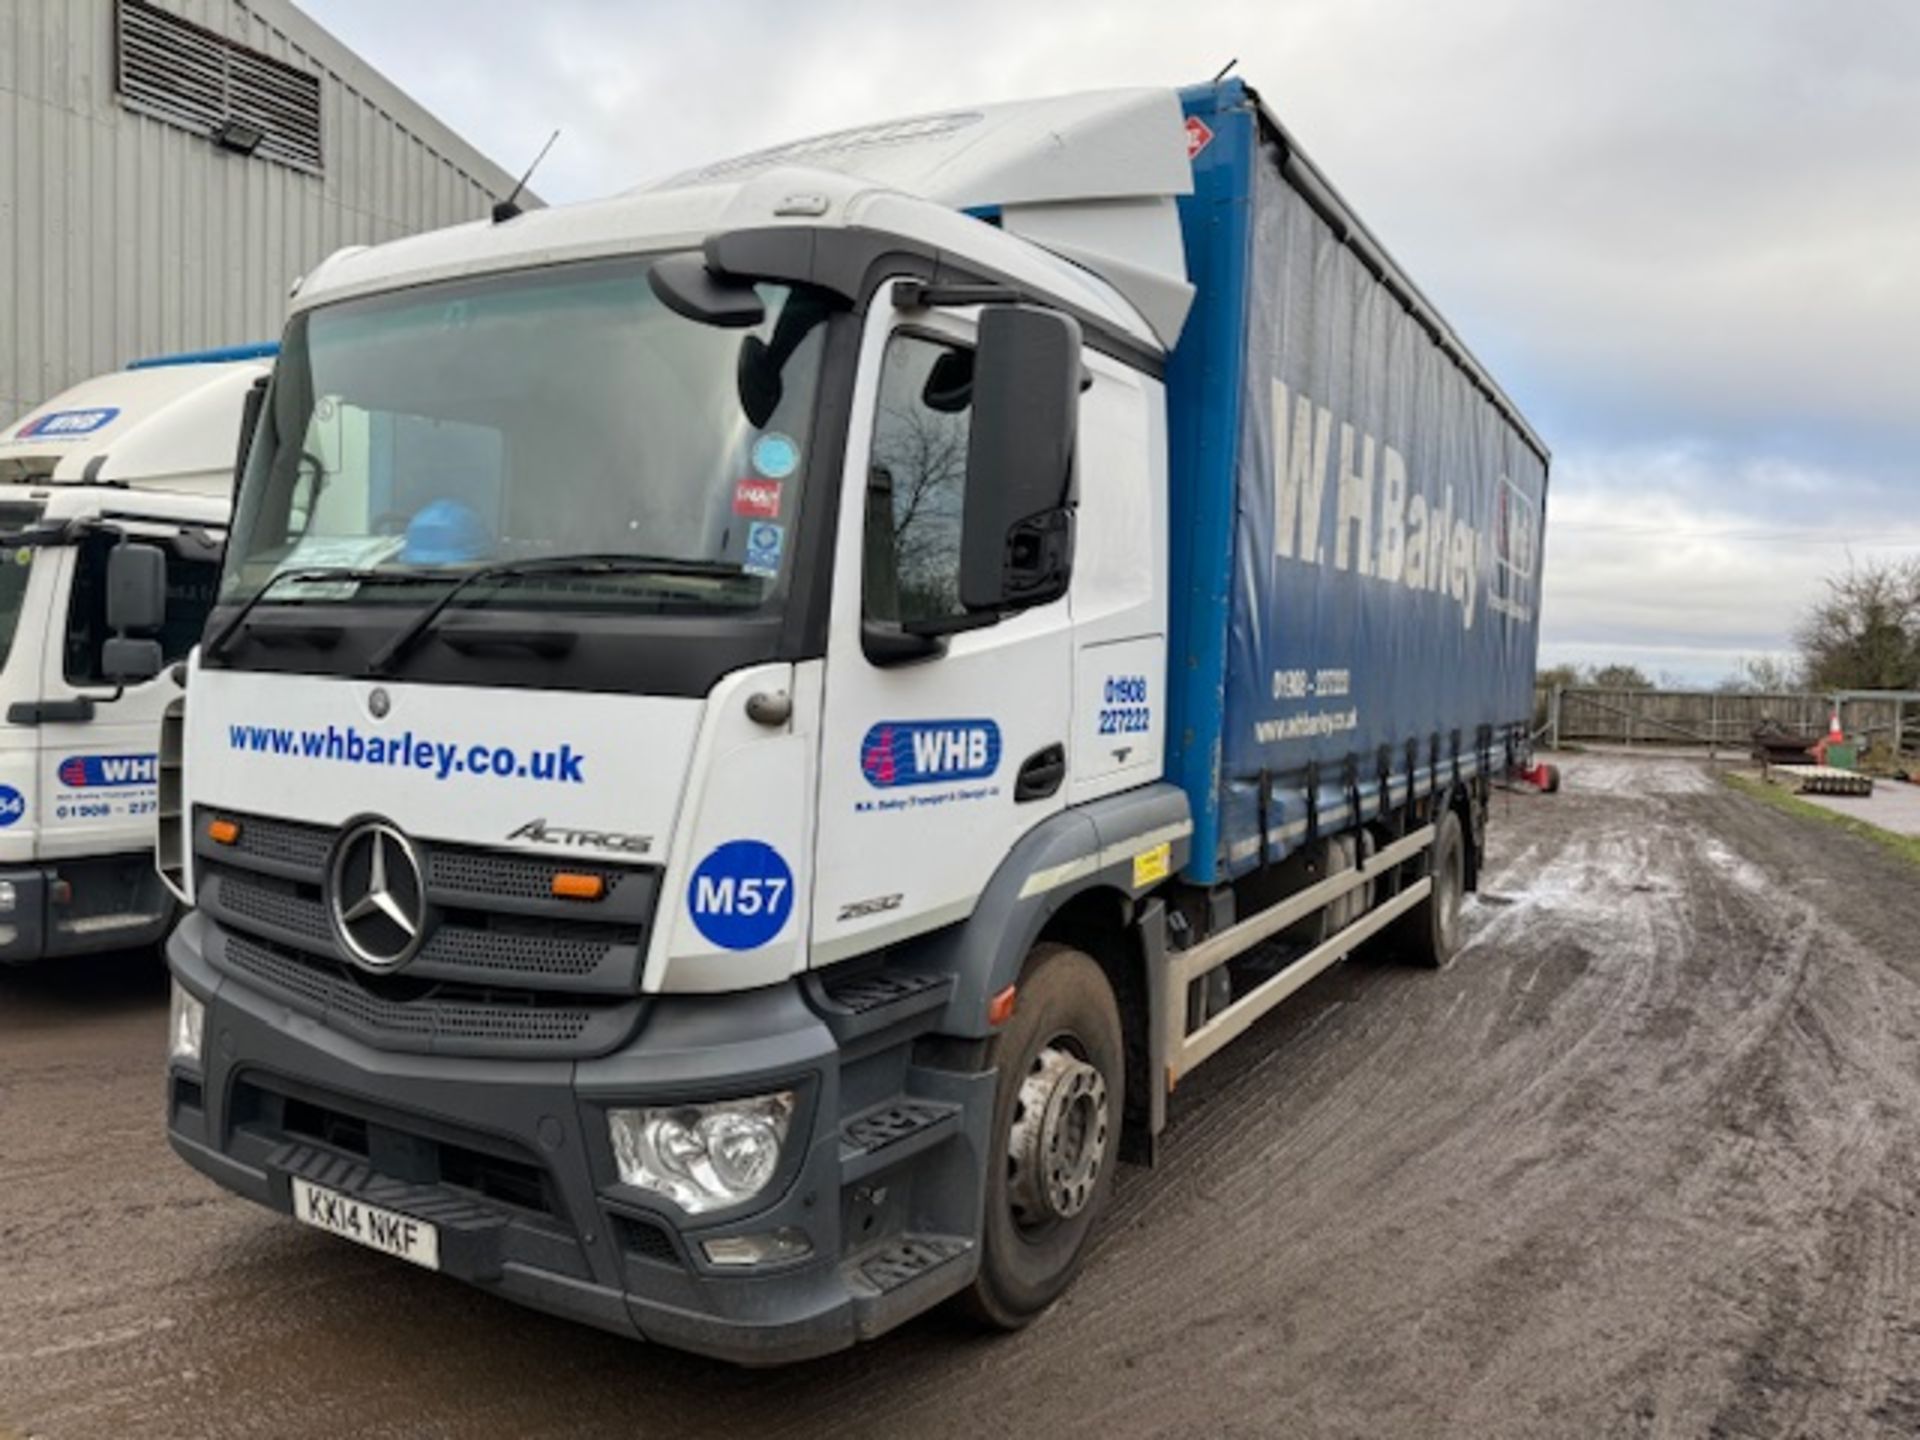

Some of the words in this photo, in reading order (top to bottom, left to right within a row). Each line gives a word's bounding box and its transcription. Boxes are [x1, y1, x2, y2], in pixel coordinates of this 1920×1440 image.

[1103, 675, 1146, 703] 01908
[101, 758, 157, 782] WH
[229, 723, 585, 784] www.whbarley.co.uk
[912, 728, 988, 774] WHB
[696, 875, 787, 916] M57
[308, 1187, 361, 1237] KX14
[368, 1210, 418, 1255] NKF
